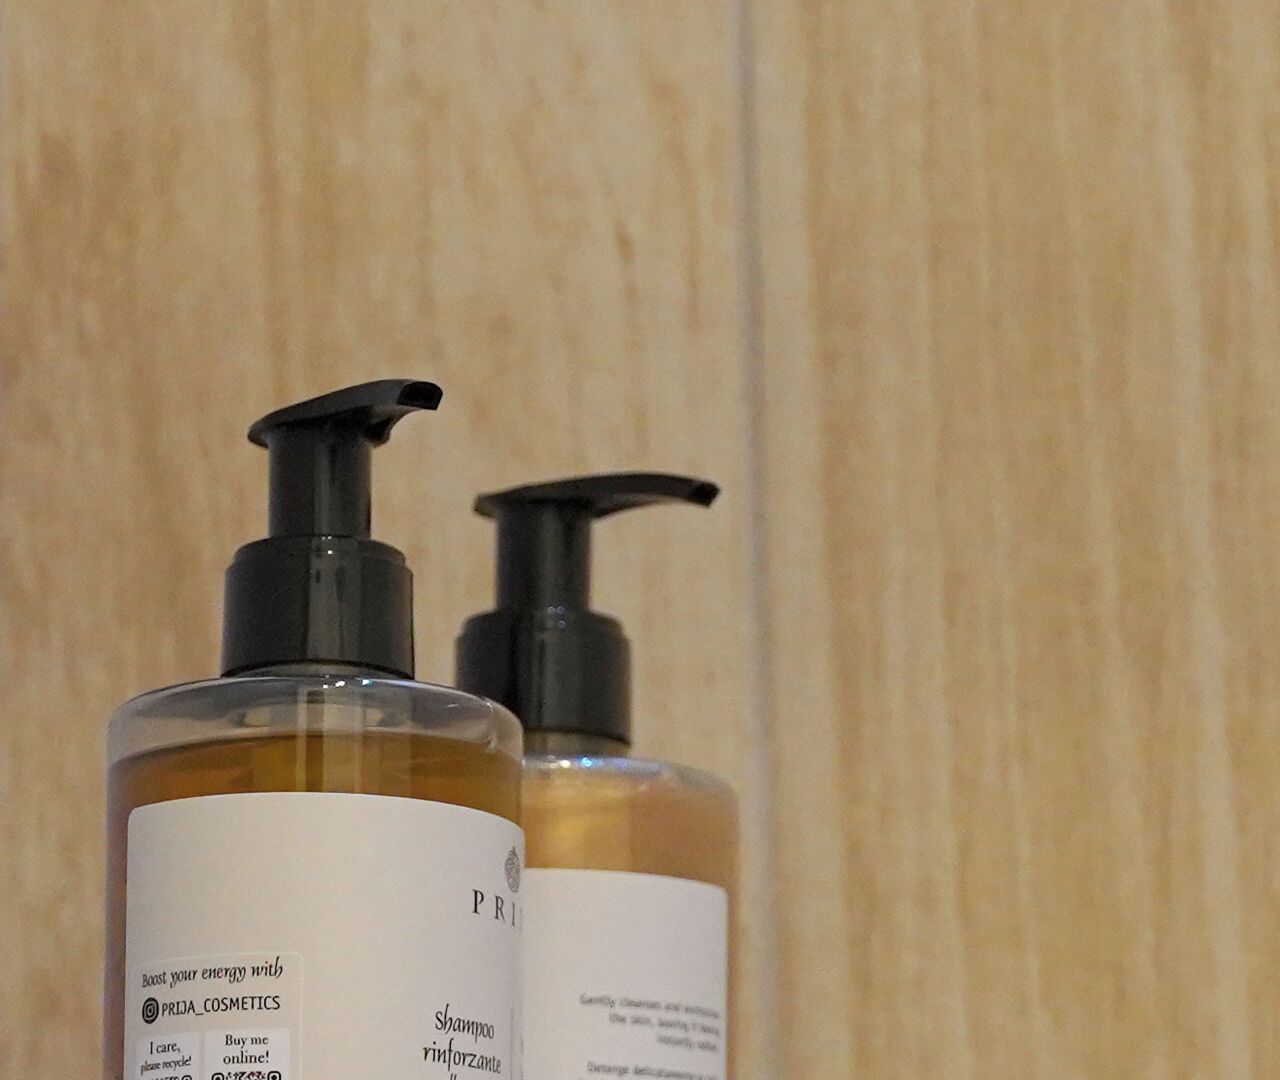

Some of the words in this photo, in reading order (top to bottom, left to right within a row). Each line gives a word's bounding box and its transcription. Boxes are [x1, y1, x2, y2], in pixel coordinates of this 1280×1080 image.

[141, 971, 167, 988] Boost
[169, 967, 198, 989] your
[201, 964, 246, 984] energy
[251, 955, 283, 980] with
[161, 995, 281, 1017] PRIJA_COSMETICS
[434, 1003, 495, 1043] Shampoo
[149, 1042, 154, 1055] I
[155, 1042, 181, 1055] care,
[224, 1034, 248, 1049] Buy
[250, 1036, 269, 1046] me
[222, 1050, 270, 1065] online!
[421, 1037, 503, 1075] rinforzante
